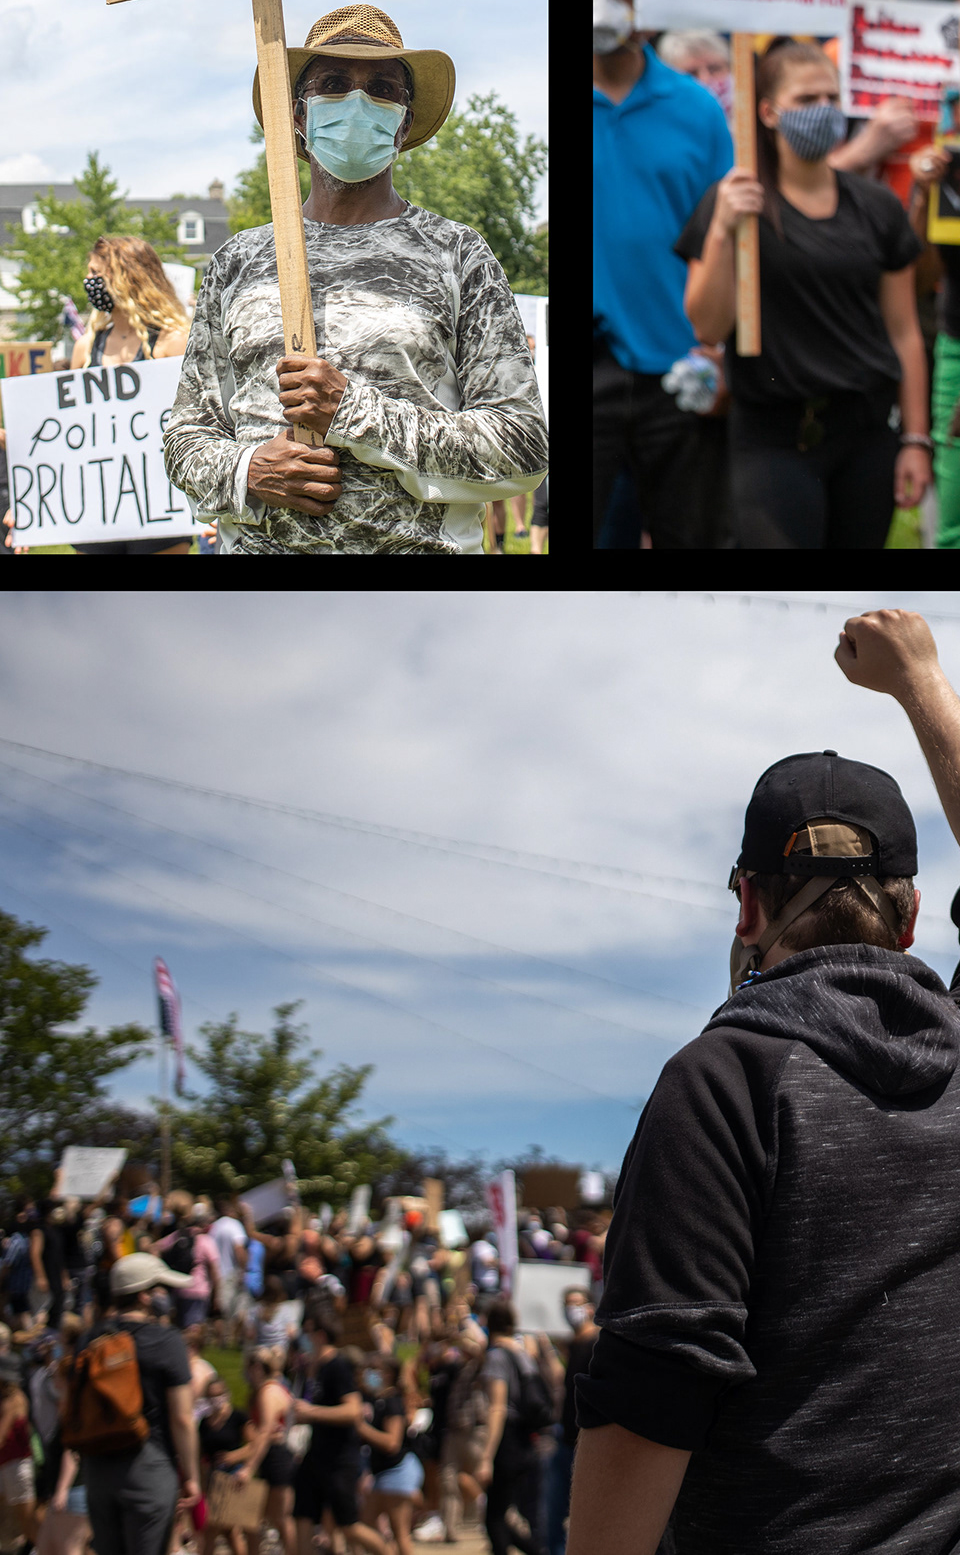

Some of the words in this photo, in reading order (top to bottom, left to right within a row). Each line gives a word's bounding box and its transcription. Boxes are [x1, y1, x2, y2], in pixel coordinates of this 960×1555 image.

[2, 349, 46, 375] KE
[56, 365, 141, 409] END
[12, 449, 195, 531] BRUTALI
